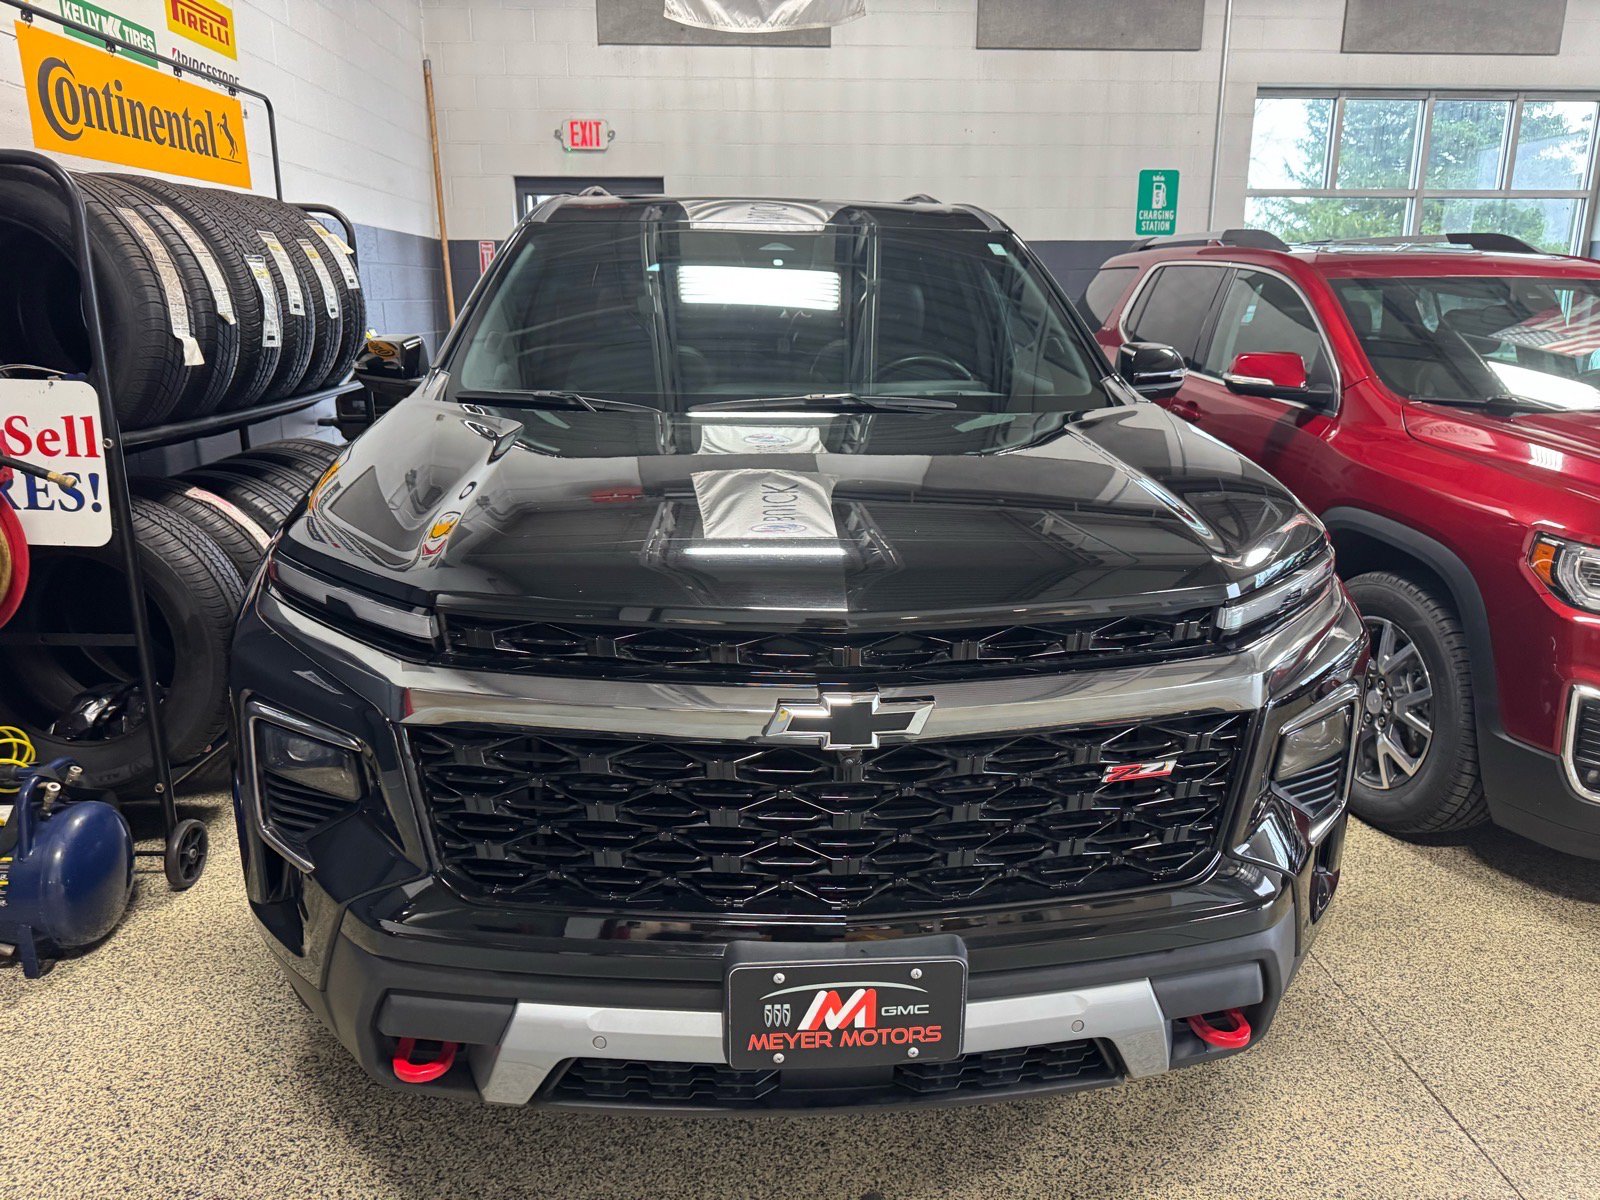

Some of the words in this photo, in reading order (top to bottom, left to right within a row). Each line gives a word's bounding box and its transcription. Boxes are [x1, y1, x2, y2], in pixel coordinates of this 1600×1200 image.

[62, 0, 100, 32] KELLY
[122, 24, 156, 54] TIRES
[171, 0, 230, 46] PIRELLI
[37, 56, 220, 159] Continental
[569, 120, 602, 148] EXIT
[1139, 209, 1175, 220] CHARGING
[1141, 220, 1171, 232] STATION
[4, 415, 101, 458] Sell
[881, 1004, 930, 1016] GMC
[747, 1031, 833, 1051] MEYER
[839, 1025, 942, 1047] MOTORS
